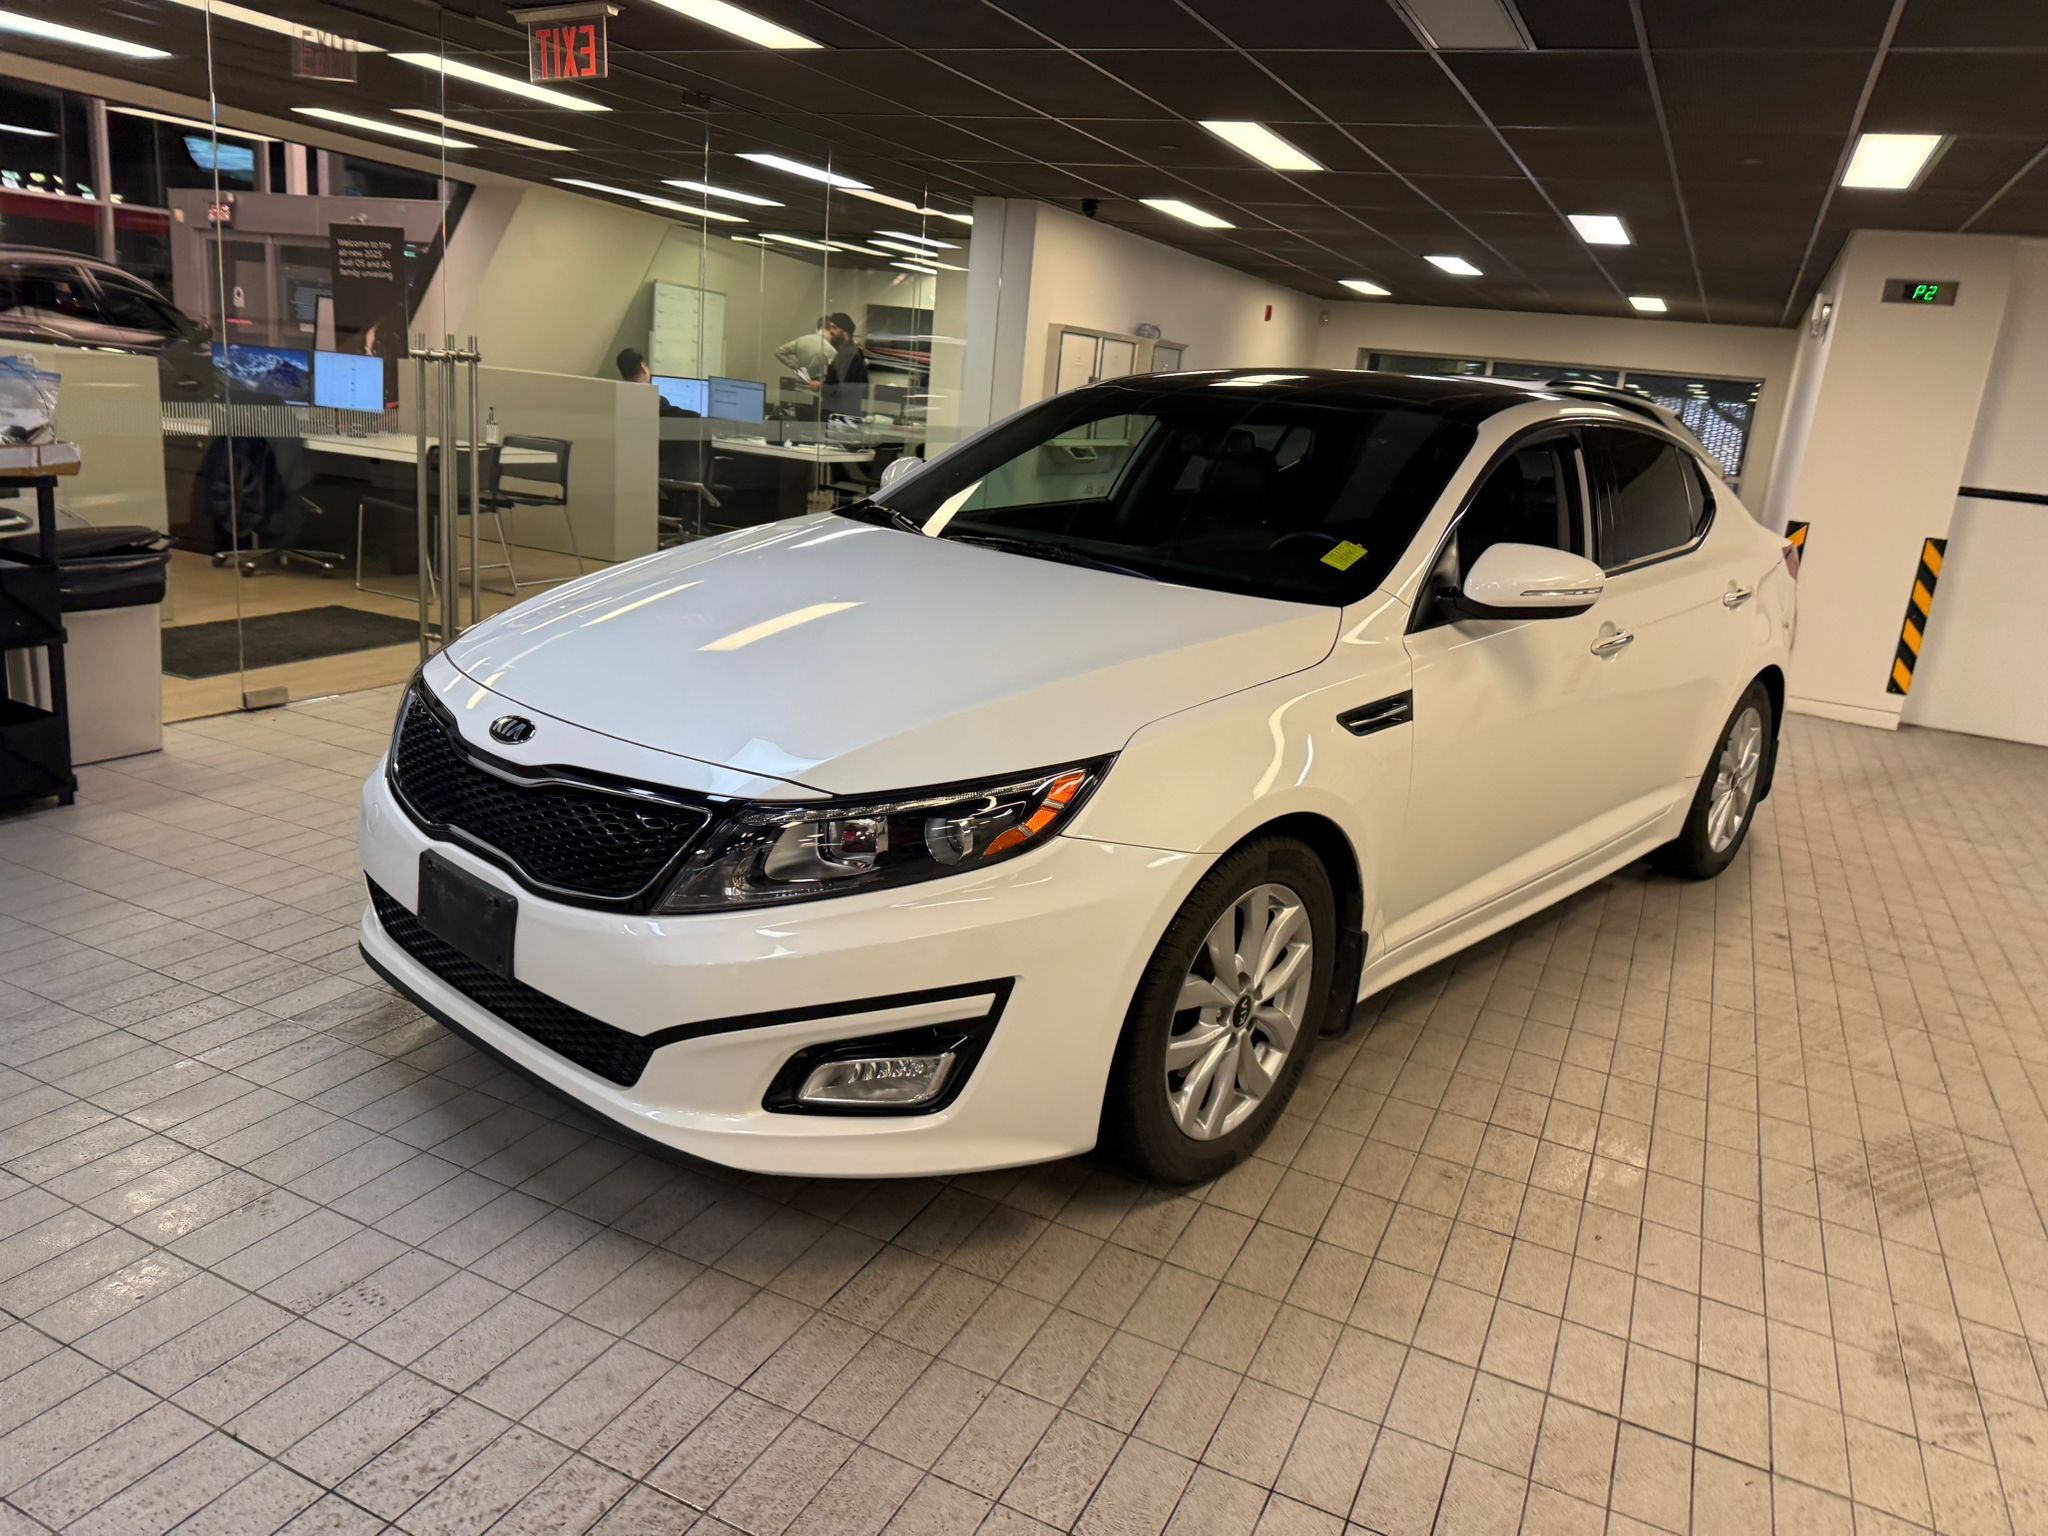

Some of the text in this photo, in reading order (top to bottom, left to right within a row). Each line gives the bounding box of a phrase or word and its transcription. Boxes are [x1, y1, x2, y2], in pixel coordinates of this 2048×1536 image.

[336, 238, 392, 250] Welcome to the
[1912, 284, 1938, 301] P2
[491, 718, 527, 741] KIA
